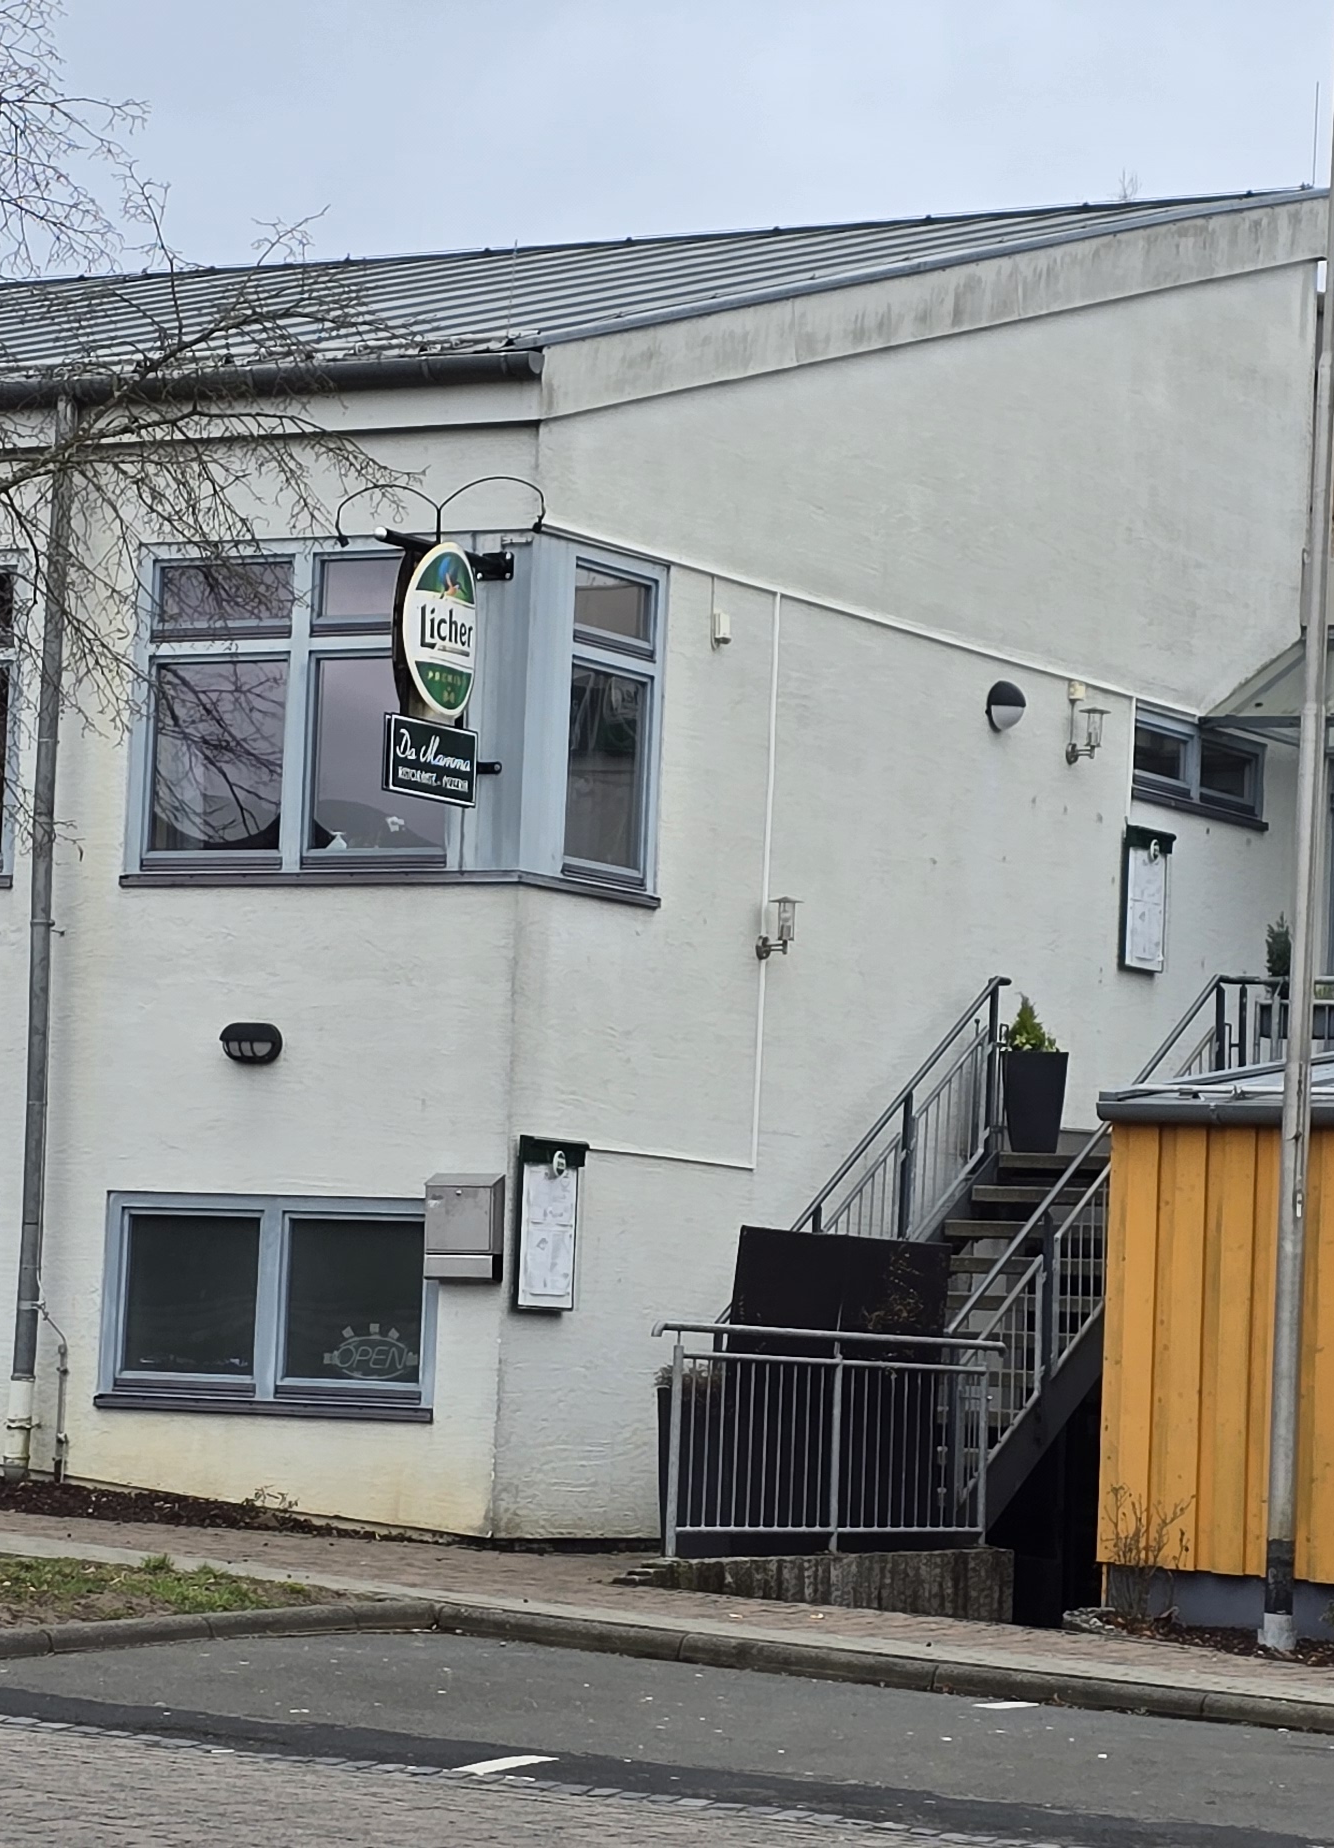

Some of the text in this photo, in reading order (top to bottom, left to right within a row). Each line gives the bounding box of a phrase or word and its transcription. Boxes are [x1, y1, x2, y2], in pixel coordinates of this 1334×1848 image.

[420, 604, 473, 650] Licher
[396, 728, 471, 772] Da Mamma
[336, 1345, 408, 1369] OPEN
